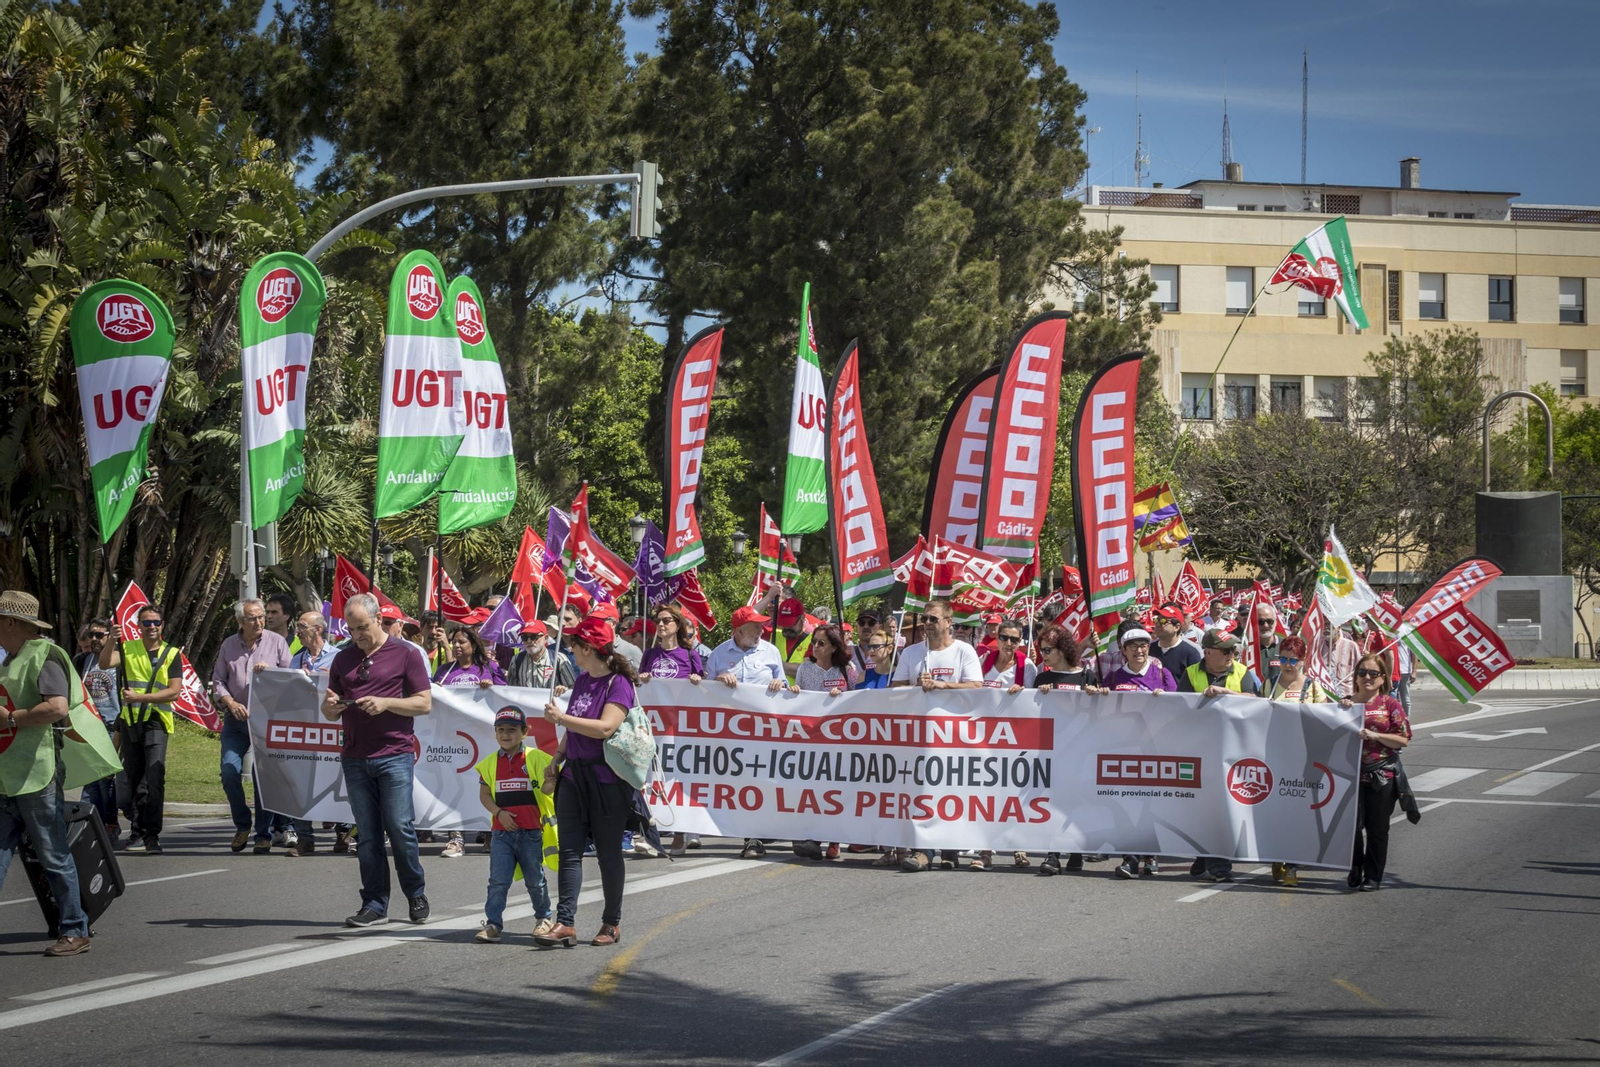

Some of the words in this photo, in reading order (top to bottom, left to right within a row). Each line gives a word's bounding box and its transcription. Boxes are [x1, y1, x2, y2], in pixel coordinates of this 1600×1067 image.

[263, 277, 296, 299] UGT
[410, 273, 436, 296] UGT
[103, 301, 147, 322] UGT
[456, 299, 480, 324] UGT
[255, 364, 307, 416] UGT
[391, 368, 463, 408] UGT
[93, 379, 163, 430] UG
[797, 391, 826, 435] UG
[999, 343, 1050, 519] CCOO
[837, 383, 877, 559] CCOO
[1091, 391, 1130, 569] CCOO
[997, 521, 1035, 537] Cádiz
[847, 555, 881, 577] Cádiz
[1100, 568, 1130, 587] Cádiz
[1440, 611, 1511, 673] CCOO
[1457, 654, 1489, 684] Cádiz
[270, 725, 338, 746] CCOO
[646, 709, 665, 732] A
[677, 710, 811, 741] LUCHA
[818, 715, 1020, 746] CONTINÚA
[286, 753, 322, 761] provincial
[426, 754, 453, 763] CÁDIZ
[1101, 760, 1177, 779] CCOO
[1232, 765, 1268, 784] UGT
[1121, 789, 1161, 799] provincial
[1163, 790, 1173, 798] de
[1175, 790, 1195, 799] Cádiz
[1278, 777, 1325, 790] Andalucía
[1278, 786, 1307, 798] CÁDIZ
[649, 779, 763, 811] MERO
[776, 787, 844, 815] LAS
[855, 791, 1052, 824] PERSONAS
